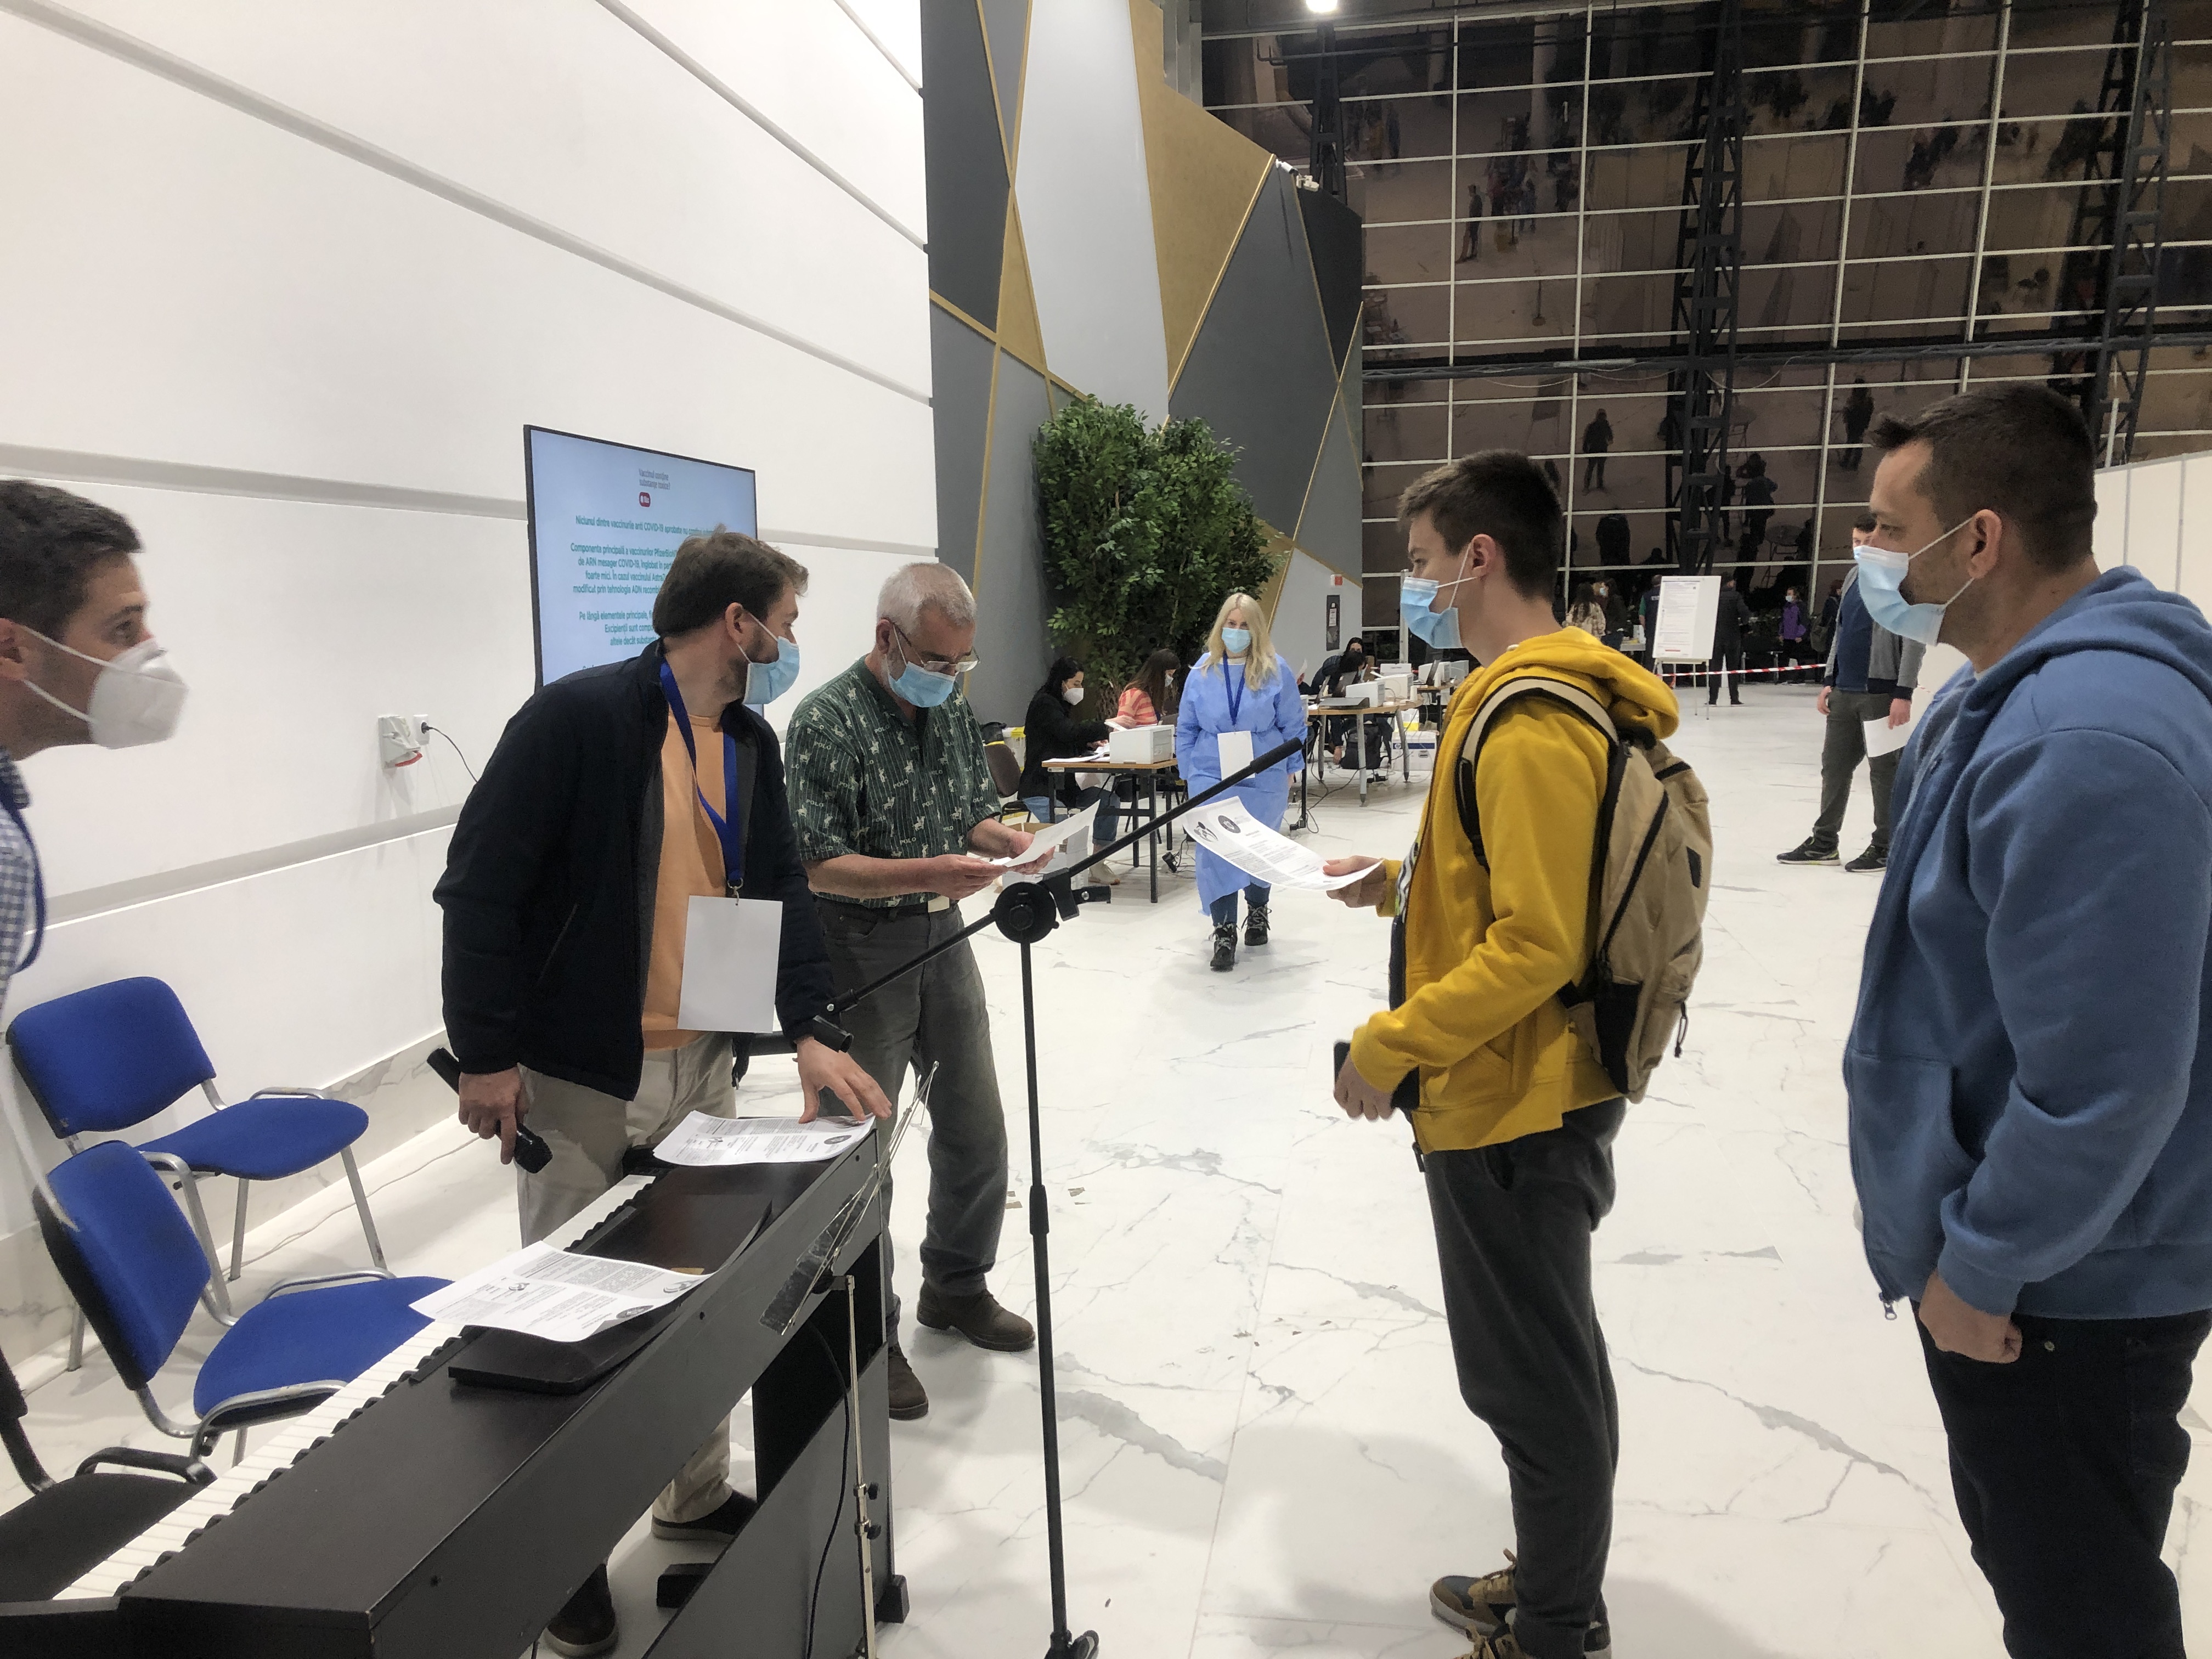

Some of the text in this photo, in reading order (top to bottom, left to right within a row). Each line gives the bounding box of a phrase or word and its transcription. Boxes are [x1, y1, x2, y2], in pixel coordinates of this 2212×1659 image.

[644, 522, 663, 533] COVID-19
[571, 542, 602, 554] Componenta
[578, 556, 585, 566] de
[585, 557, 596, 566] ARN
[597, 559, 617, 568] mesager
[585, 570, 600, 580] foarte
[573, 583, 596, 593] modificat
[597, 584, 606, 595] prin
[631, 584, 642, 594] ADN
[579, 611, 586, 620] Pe
[629, 623, 638, 632] sunt
[893, 778, 909, 789] POLO
[806, 798, 824, 808] POLO
[899, 837, 917, 846] POLO
